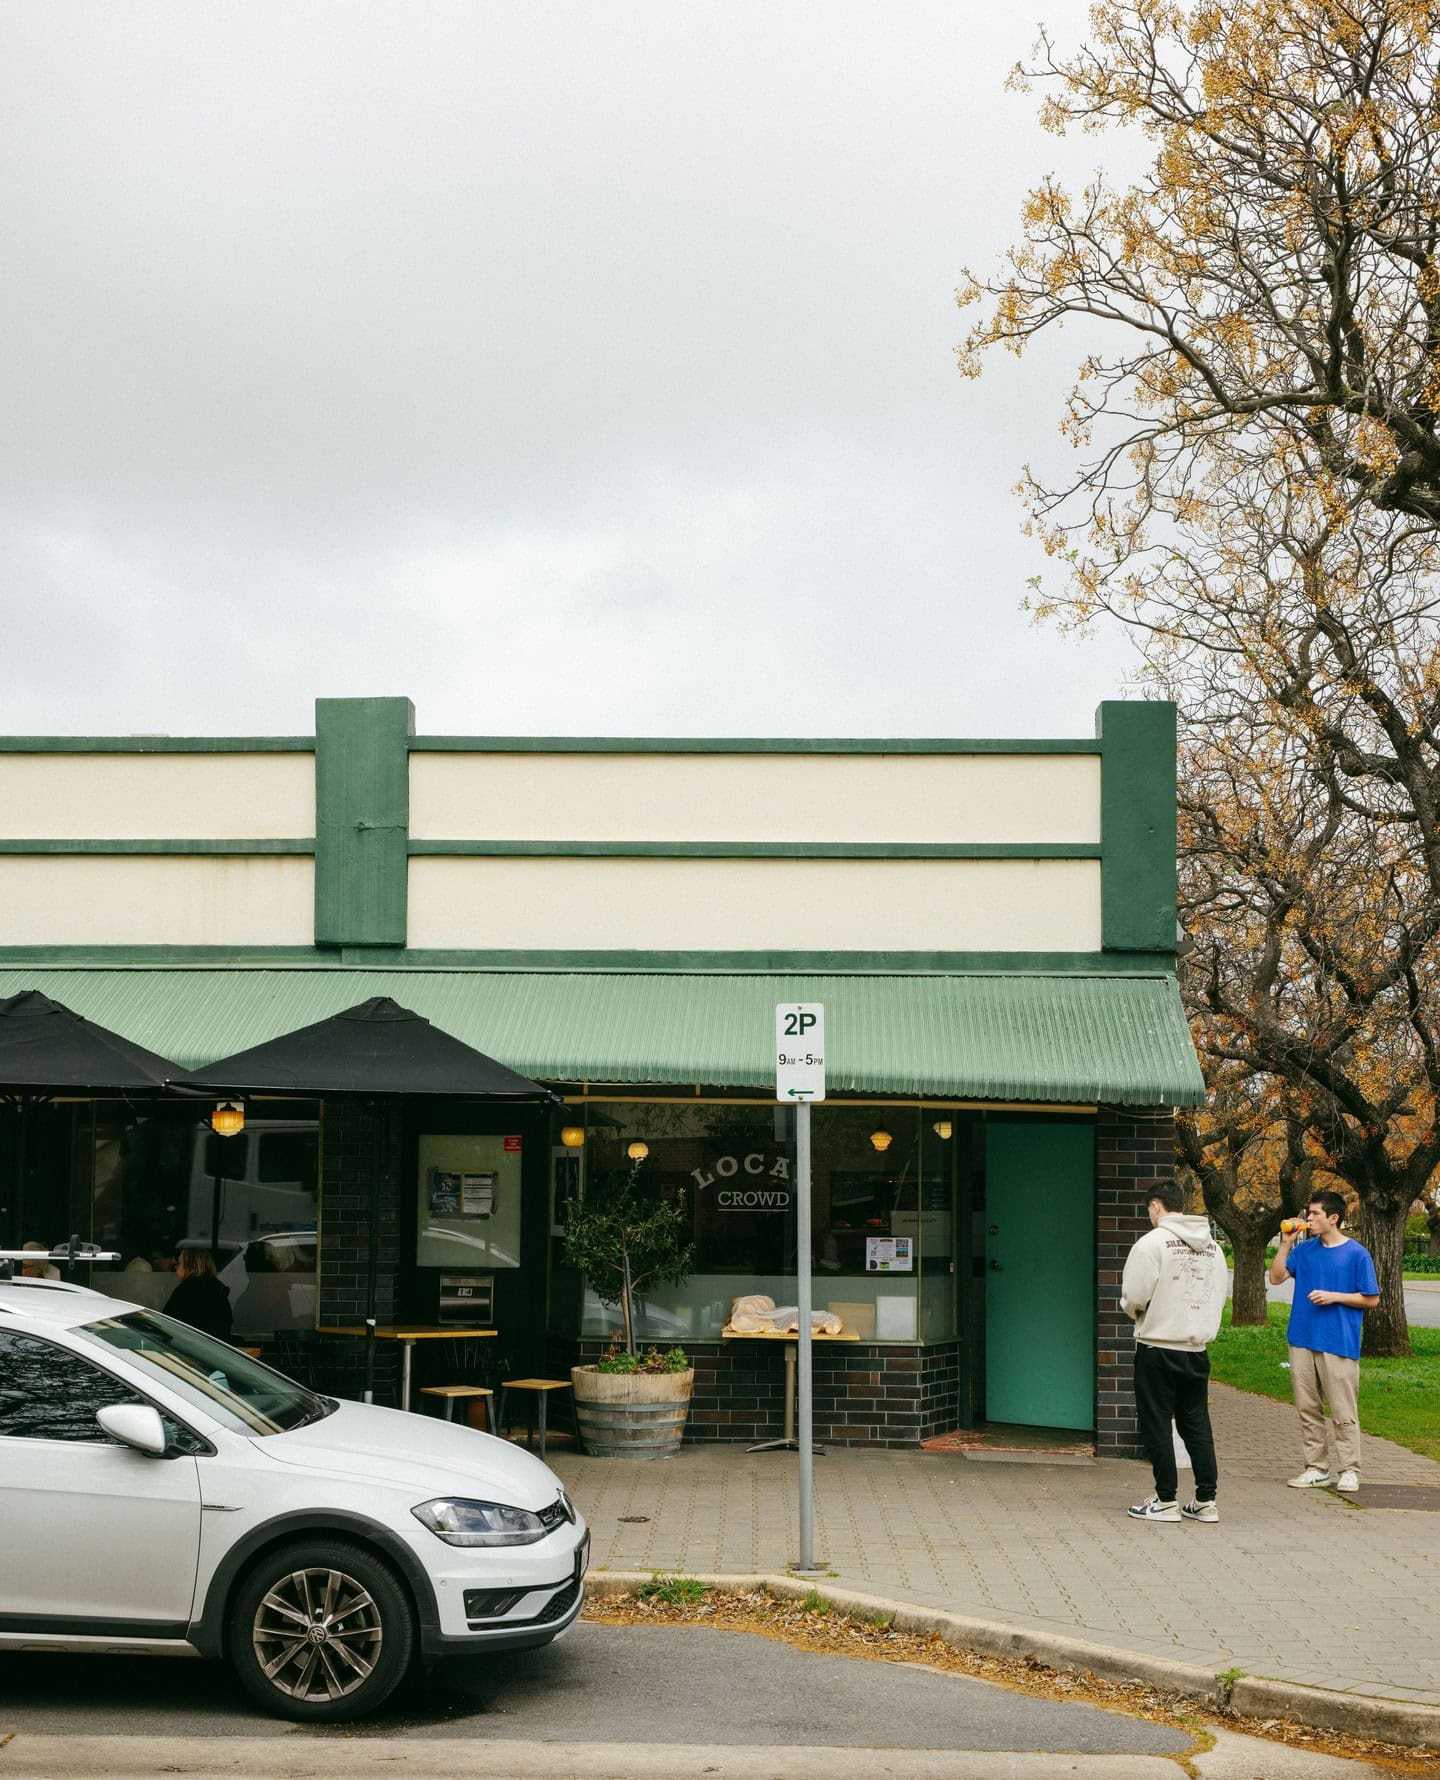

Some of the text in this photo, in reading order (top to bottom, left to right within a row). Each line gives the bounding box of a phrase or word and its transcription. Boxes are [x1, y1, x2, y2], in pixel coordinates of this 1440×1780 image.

[784, 1013, 817, 1036] 2P
[778, 1053, 796, 1065] 9AM
[805, 1053, 823, 1065] 5PM
[690, 1154, 813, 1189] LOCA
[718, 1191, 789, 1206] CROWD
